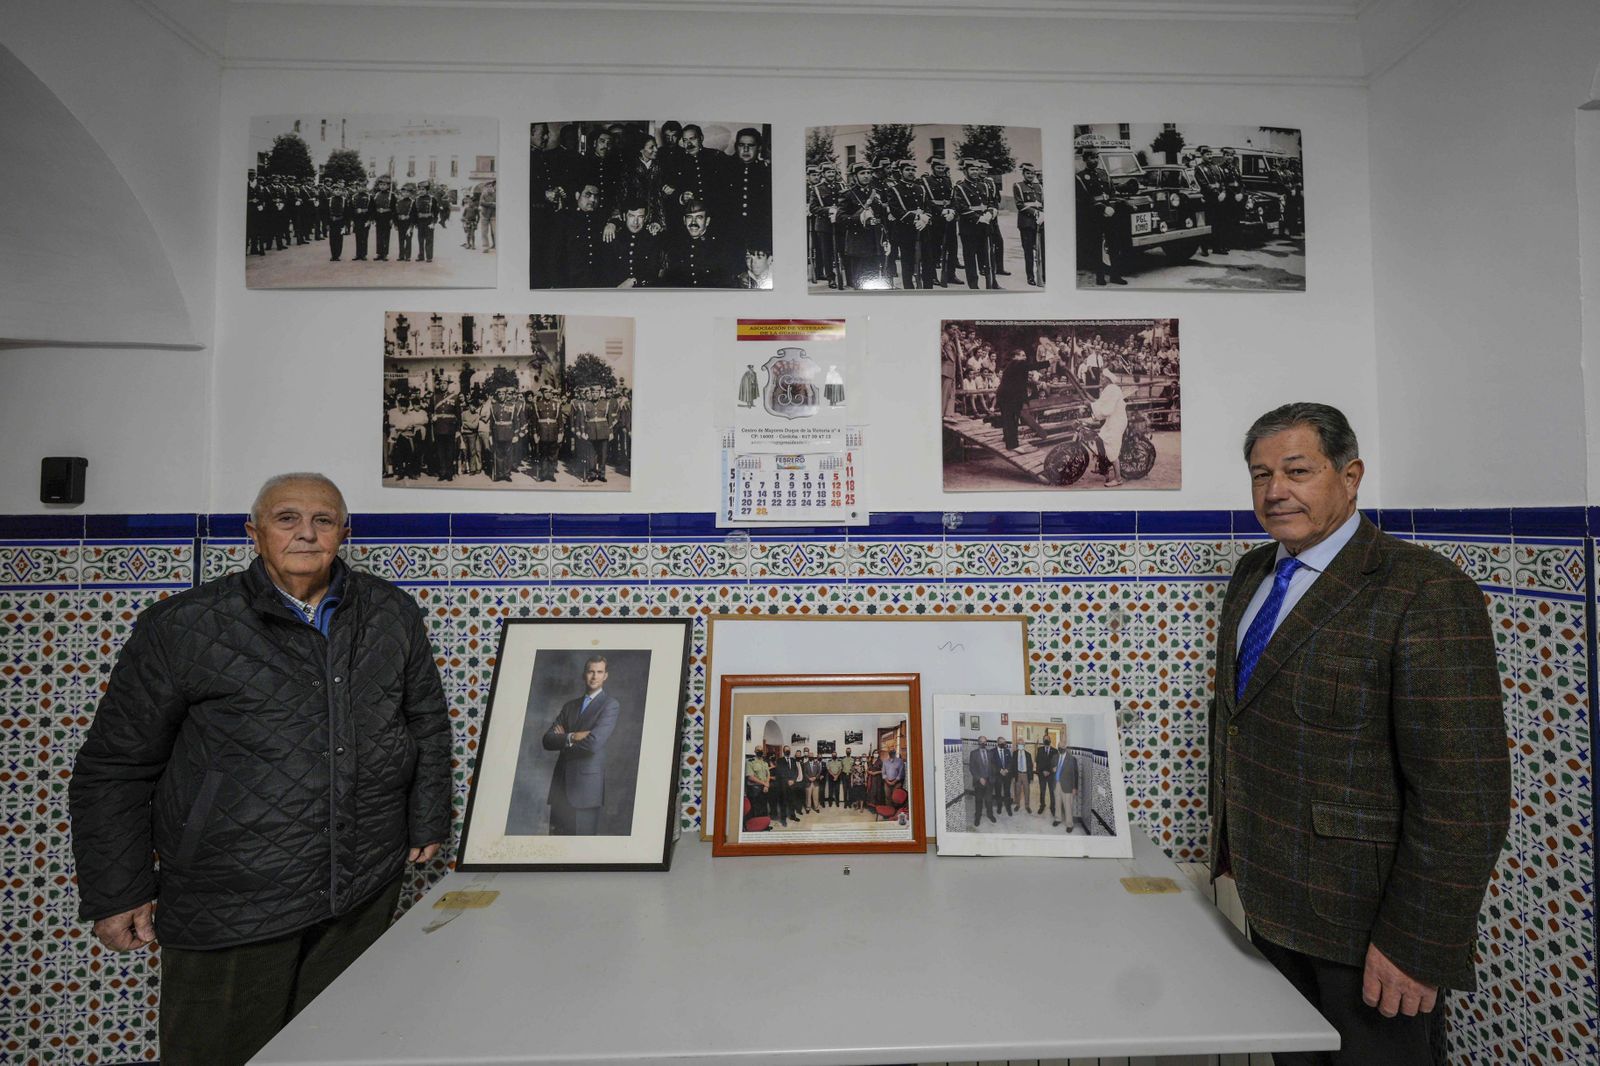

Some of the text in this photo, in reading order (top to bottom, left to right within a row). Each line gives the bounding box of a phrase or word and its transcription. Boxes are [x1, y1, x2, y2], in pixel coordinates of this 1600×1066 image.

[846, 452, 852, 463] 4
[730, 468, 736, 480] 5
[845, 466, 854, 477] 11
[744, 481, 841, 489] 6 7 8 9 10 11 12
[845, 480, 855, 491] 18
[743, 490, 841, 498] 13 14 15 16 17 18 19
[845, 494, 855, 505] 25
[741, 507, 752, 515] 27
